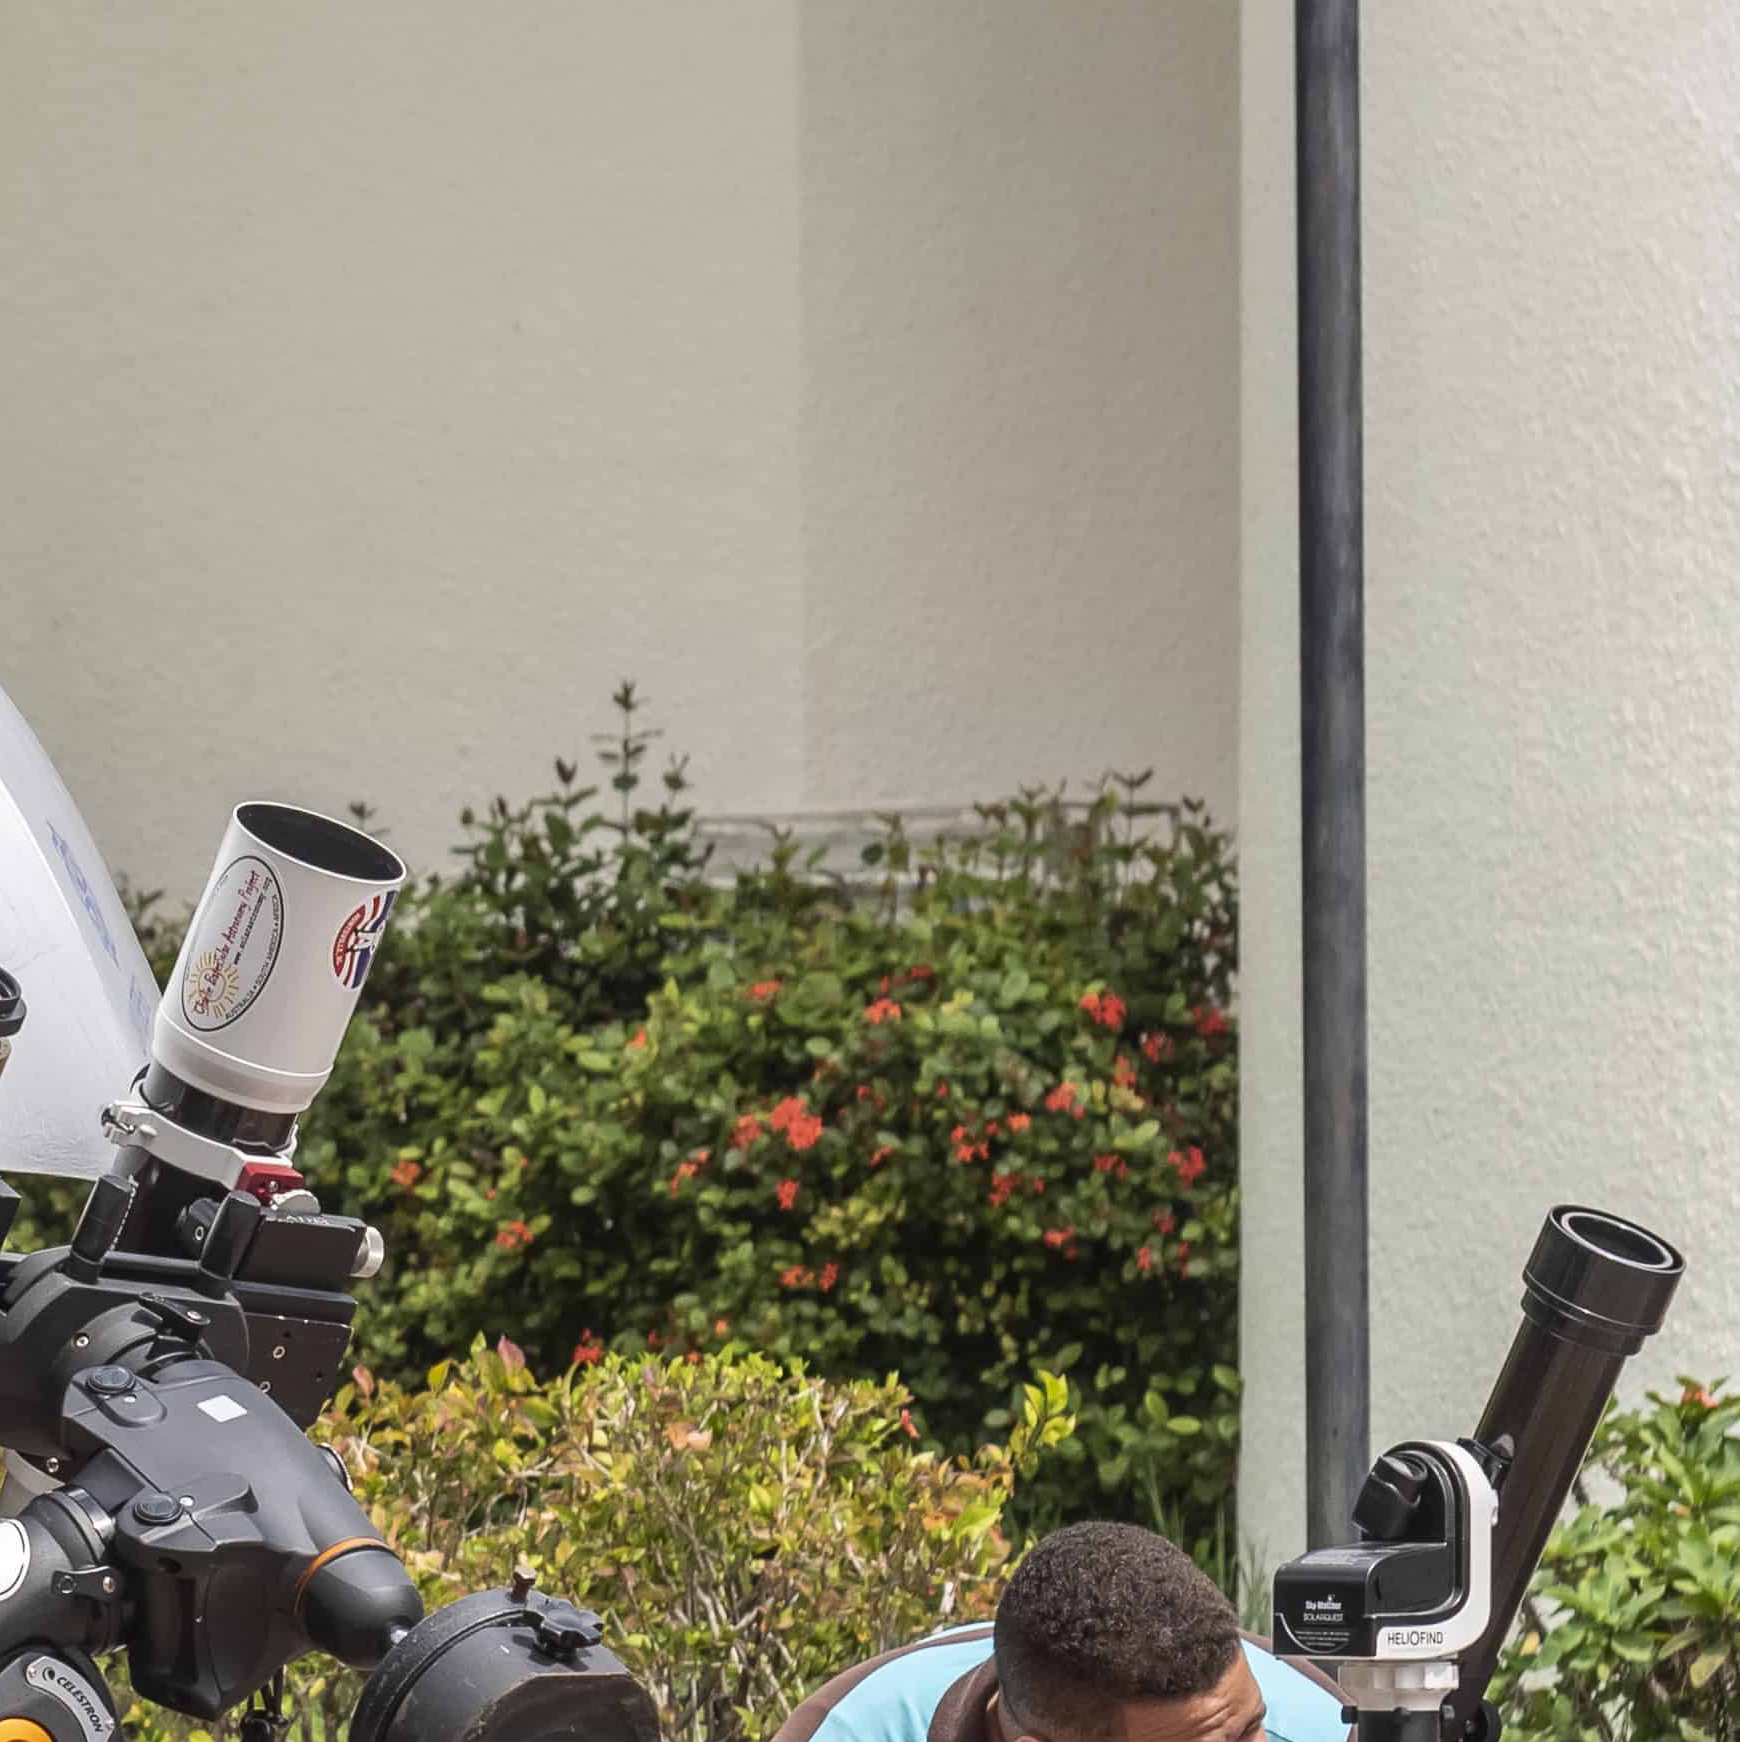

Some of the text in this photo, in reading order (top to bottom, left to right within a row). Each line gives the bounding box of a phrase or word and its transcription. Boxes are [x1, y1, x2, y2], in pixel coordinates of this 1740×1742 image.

[237, 869, 261, 902] Project
[1387, 1631, 1444, 1646] HELIOFIND
[57, 1676, 104, 1733] CELESTRON
